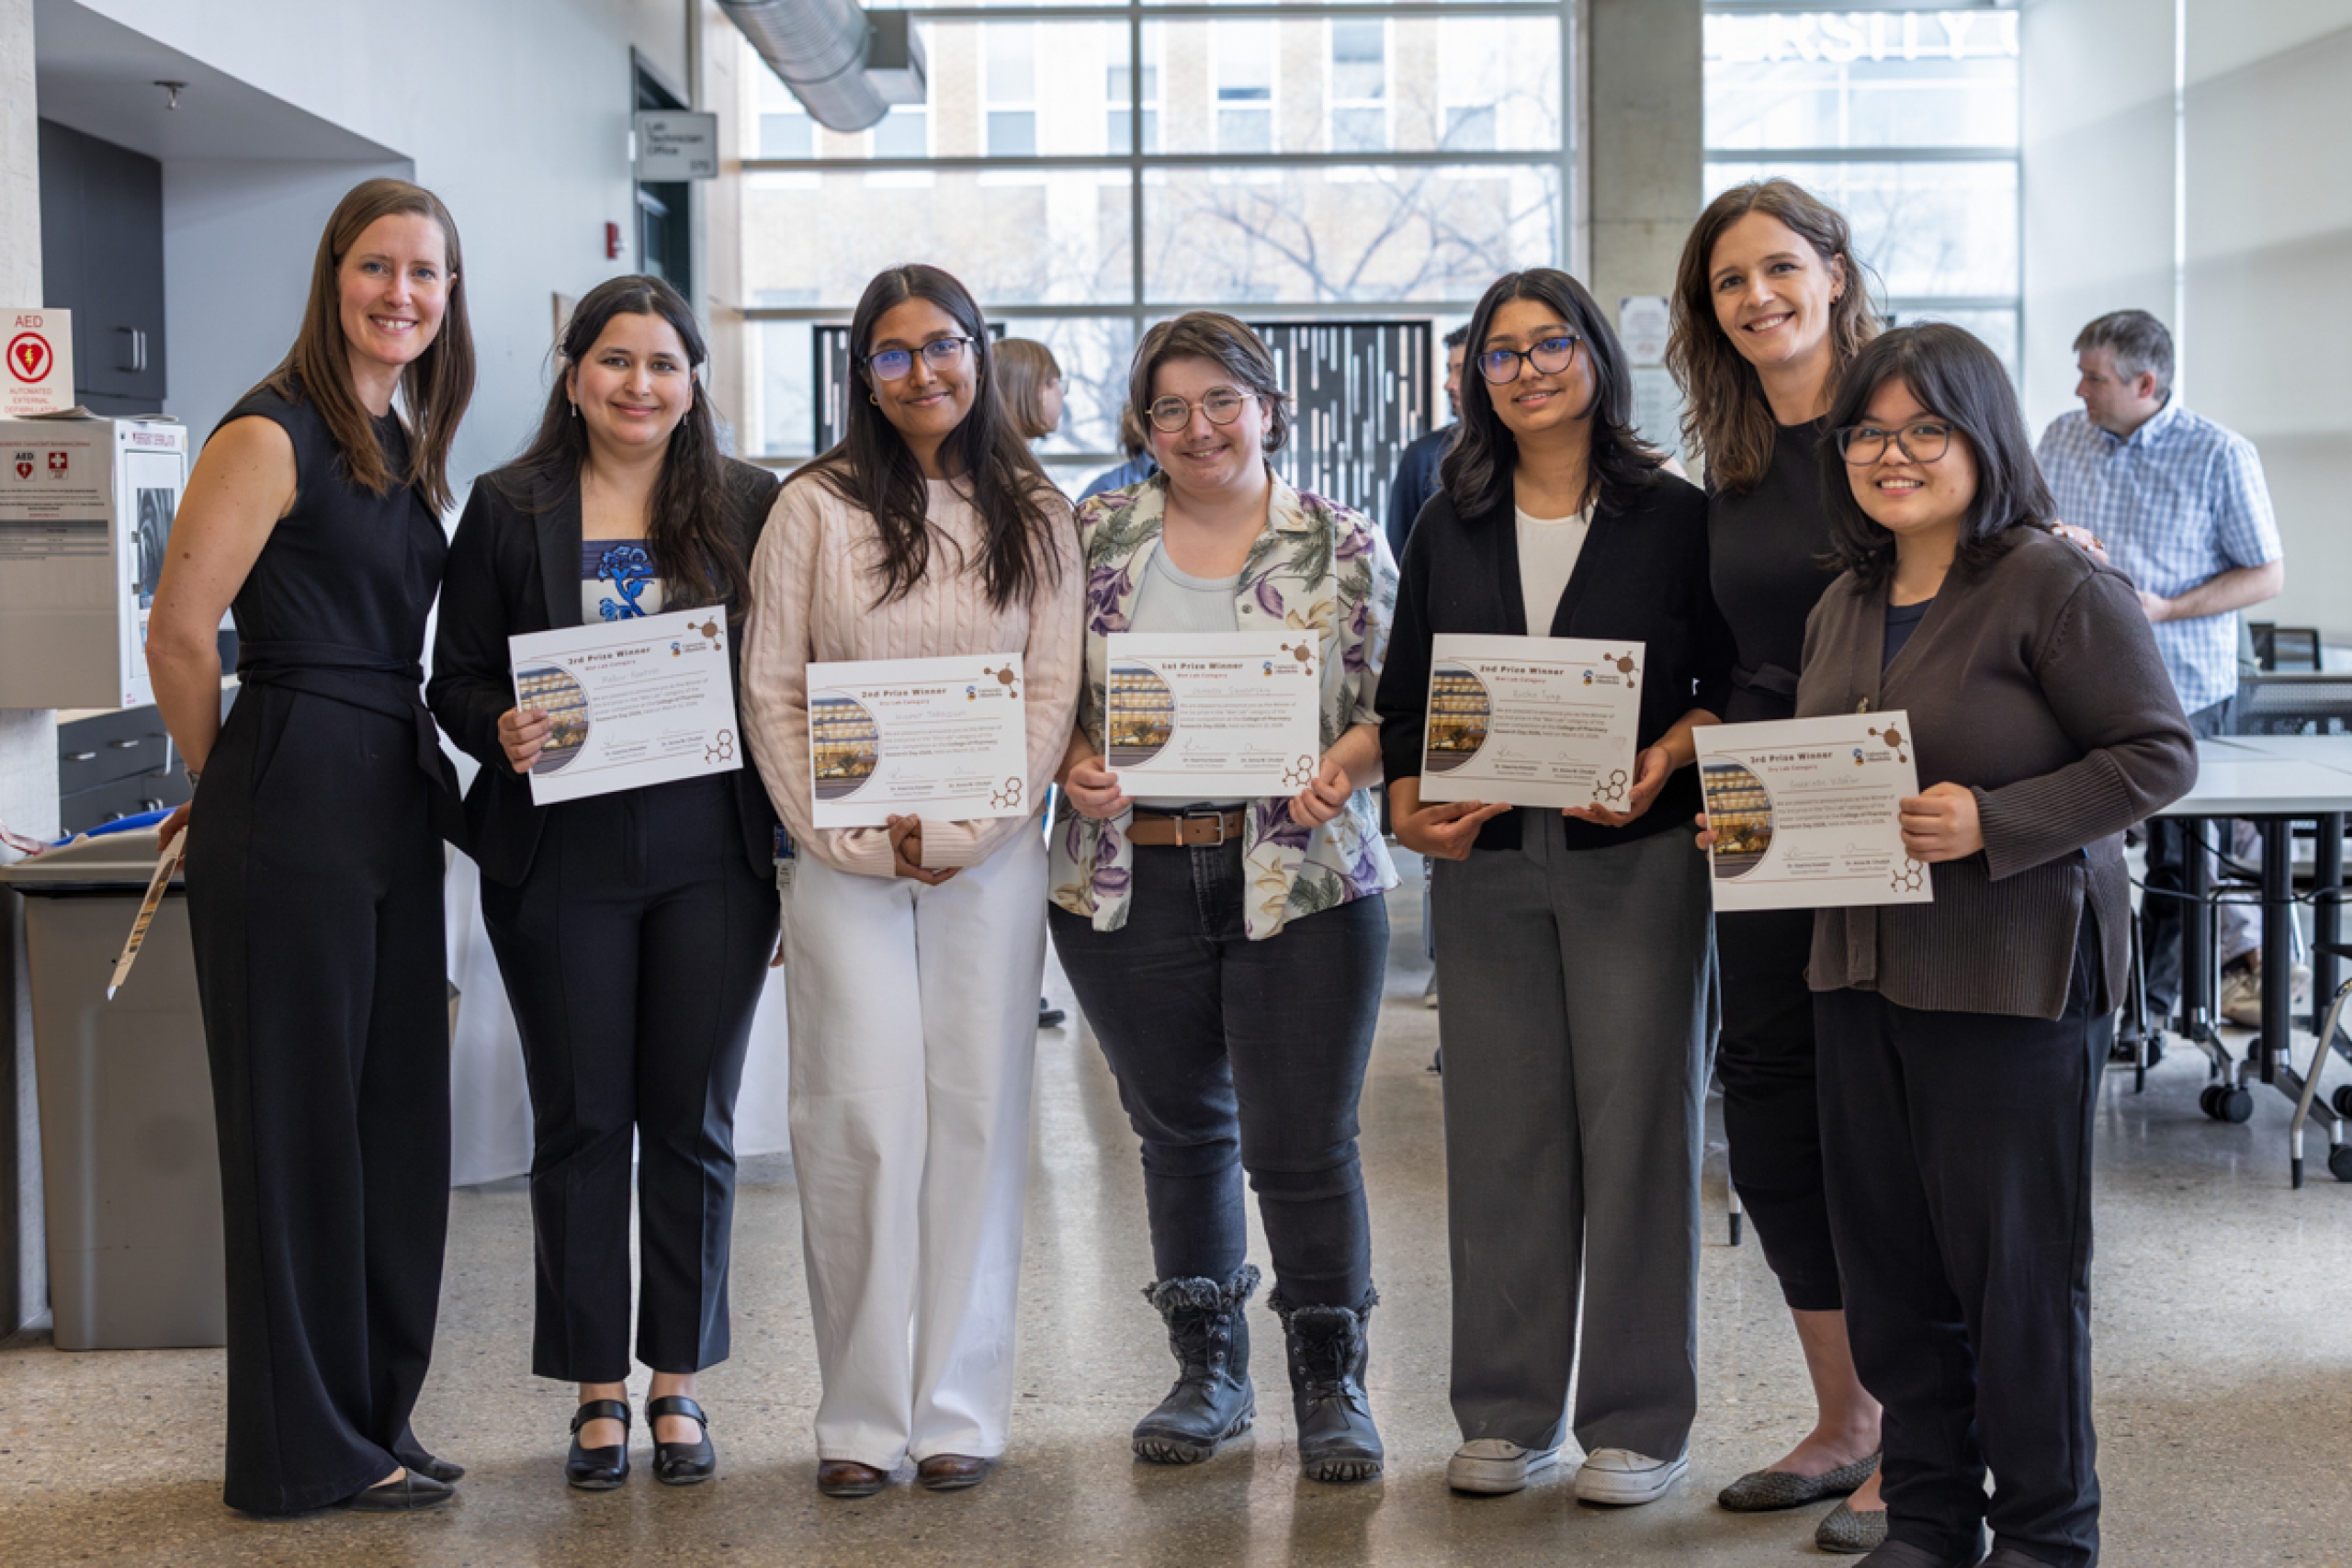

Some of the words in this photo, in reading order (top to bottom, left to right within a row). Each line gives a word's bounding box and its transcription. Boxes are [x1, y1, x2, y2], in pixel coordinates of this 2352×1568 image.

[14, 315, 43, 328] AED
[12, 397, 50, 405] EXTERNAL
[15, 452, 35, 461] AED
[568, 656, 585, 665] 3rd
[587, 652, 613, 662] Prize
[616, 647, 651, 658] Winner
[1161, 662, 1177, 671] 1st
[1180, 662, 1206, 671] Prize
[1208, 662, 1244, 671] Winner
[1479, 664, 1498, 673] 2nd
[1500, 665, 1526, 673] Prize
[1528, 666, 1566, 676] Winner
[861, 690, 879, 699] 2nd
[883, 689, 909, 698] Prize
[911, 687, 947, 696] Winner
[1750, 755, 1766, 764] 3rd
[1769, 753, 1794, 762] Prize
[1797, 751, 1833, 761] Winner
